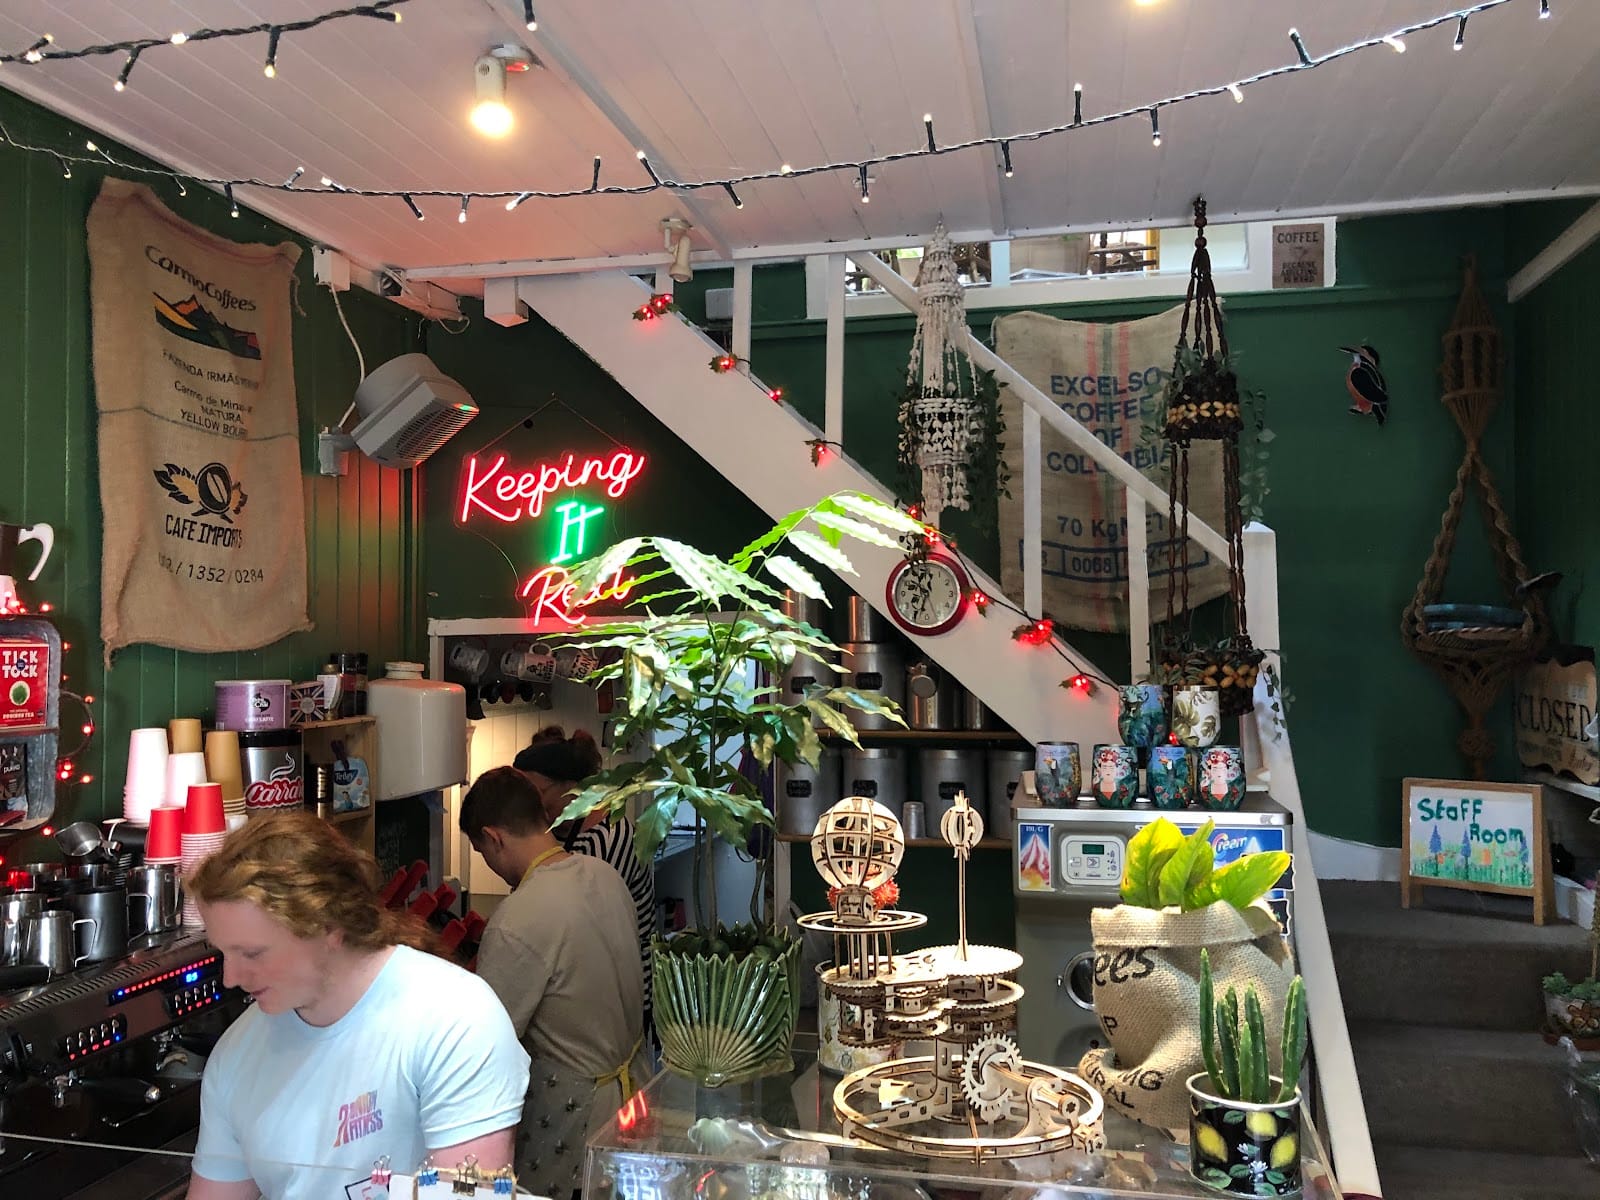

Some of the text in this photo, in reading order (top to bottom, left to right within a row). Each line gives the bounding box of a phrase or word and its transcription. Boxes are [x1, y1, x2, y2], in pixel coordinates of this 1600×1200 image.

[1277, 231, 1319, 244] COFFEE
[174, 381, 203, 402] Carmo
[206, 395, 218, 407] de
[1050, 366, 1161, 396] EXCELSO
[181, 409, 220, 432] YELLOW
[1060, 394, 1155, 422] COFFEE
[460, 451, 645, 523] Keeping
[165, 514, 197, 541] CAFE
[549, 500, 605, 565] It
[1057, 515, 1083, 537] 70
[1091, 518, 1118, 543] Kg
[2, 650, 38, 665] TICK
[2, 664, 38, 679] TOCK
[1517, 692, 1591, 743] CLOSED
